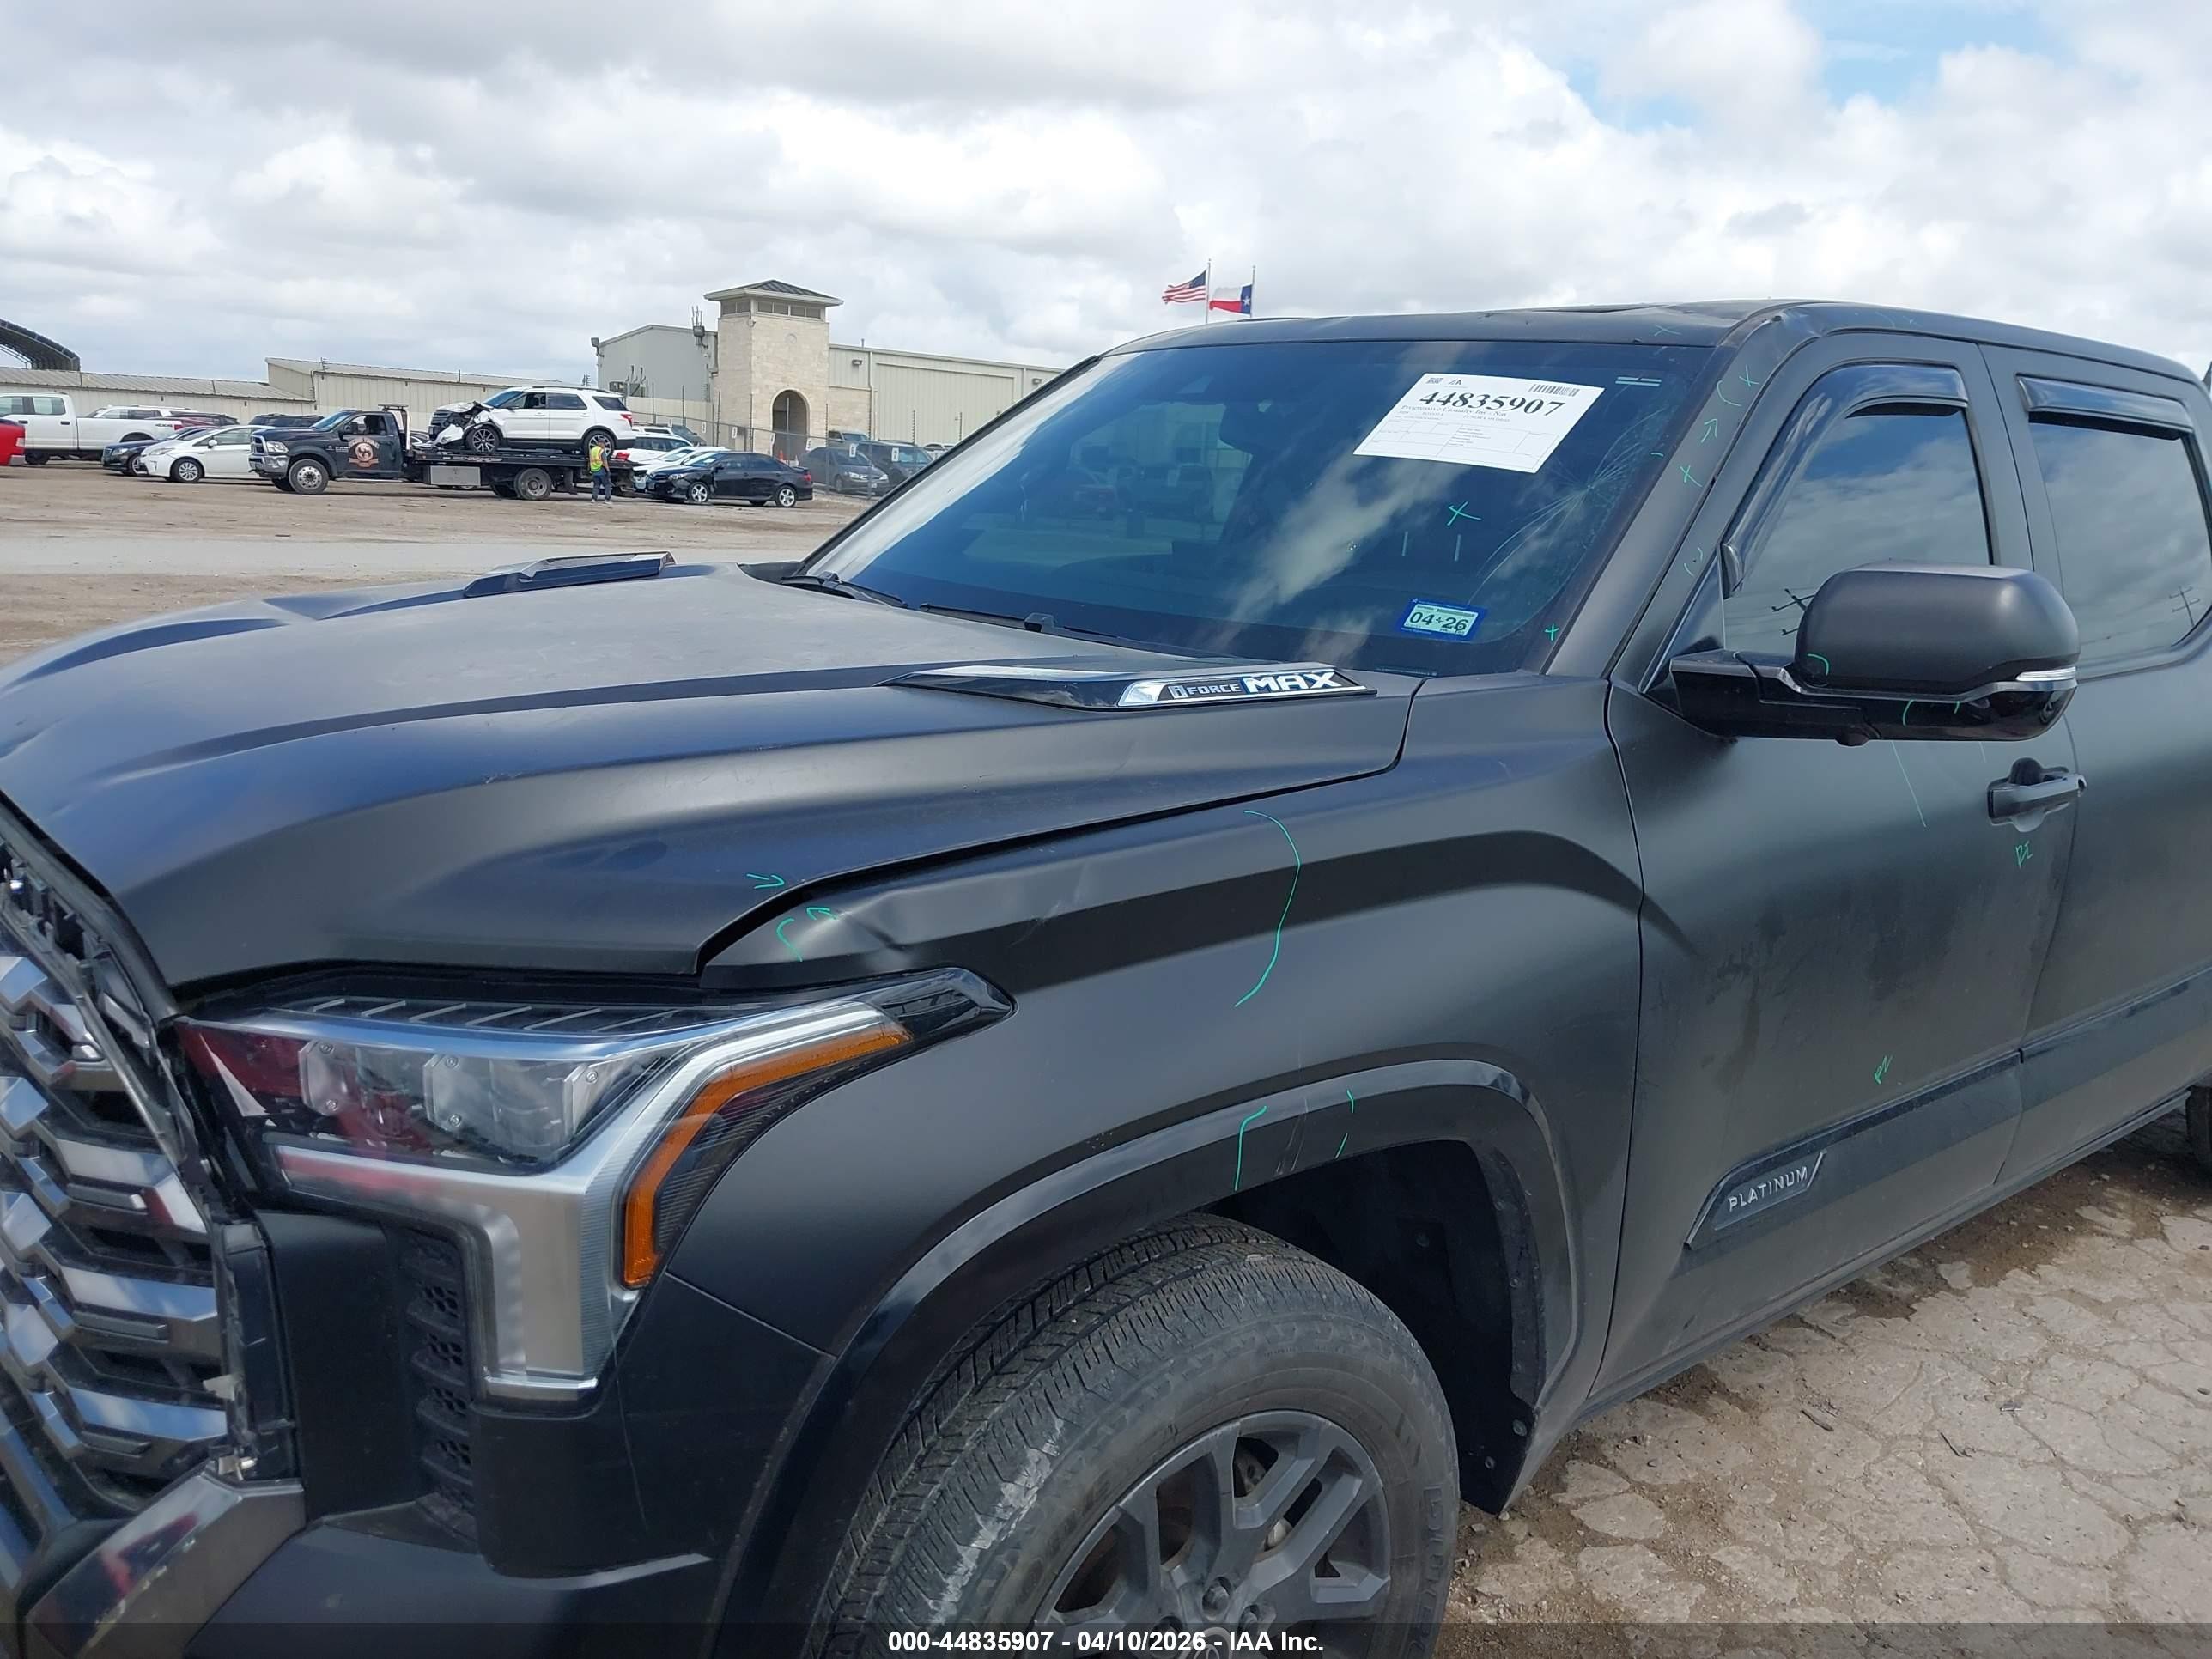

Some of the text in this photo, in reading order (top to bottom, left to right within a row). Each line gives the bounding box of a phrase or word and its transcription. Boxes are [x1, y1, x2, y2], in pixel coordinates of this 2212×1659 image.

[1419, 391, 1566, 417] 44835907
[1409, 611, 1434, 625] 04
[1441, 617, 1468, 632] 26
[1243, 671, 1342, 694] MAX
[1728, 1166, 1808, 1212] PLATINUM
